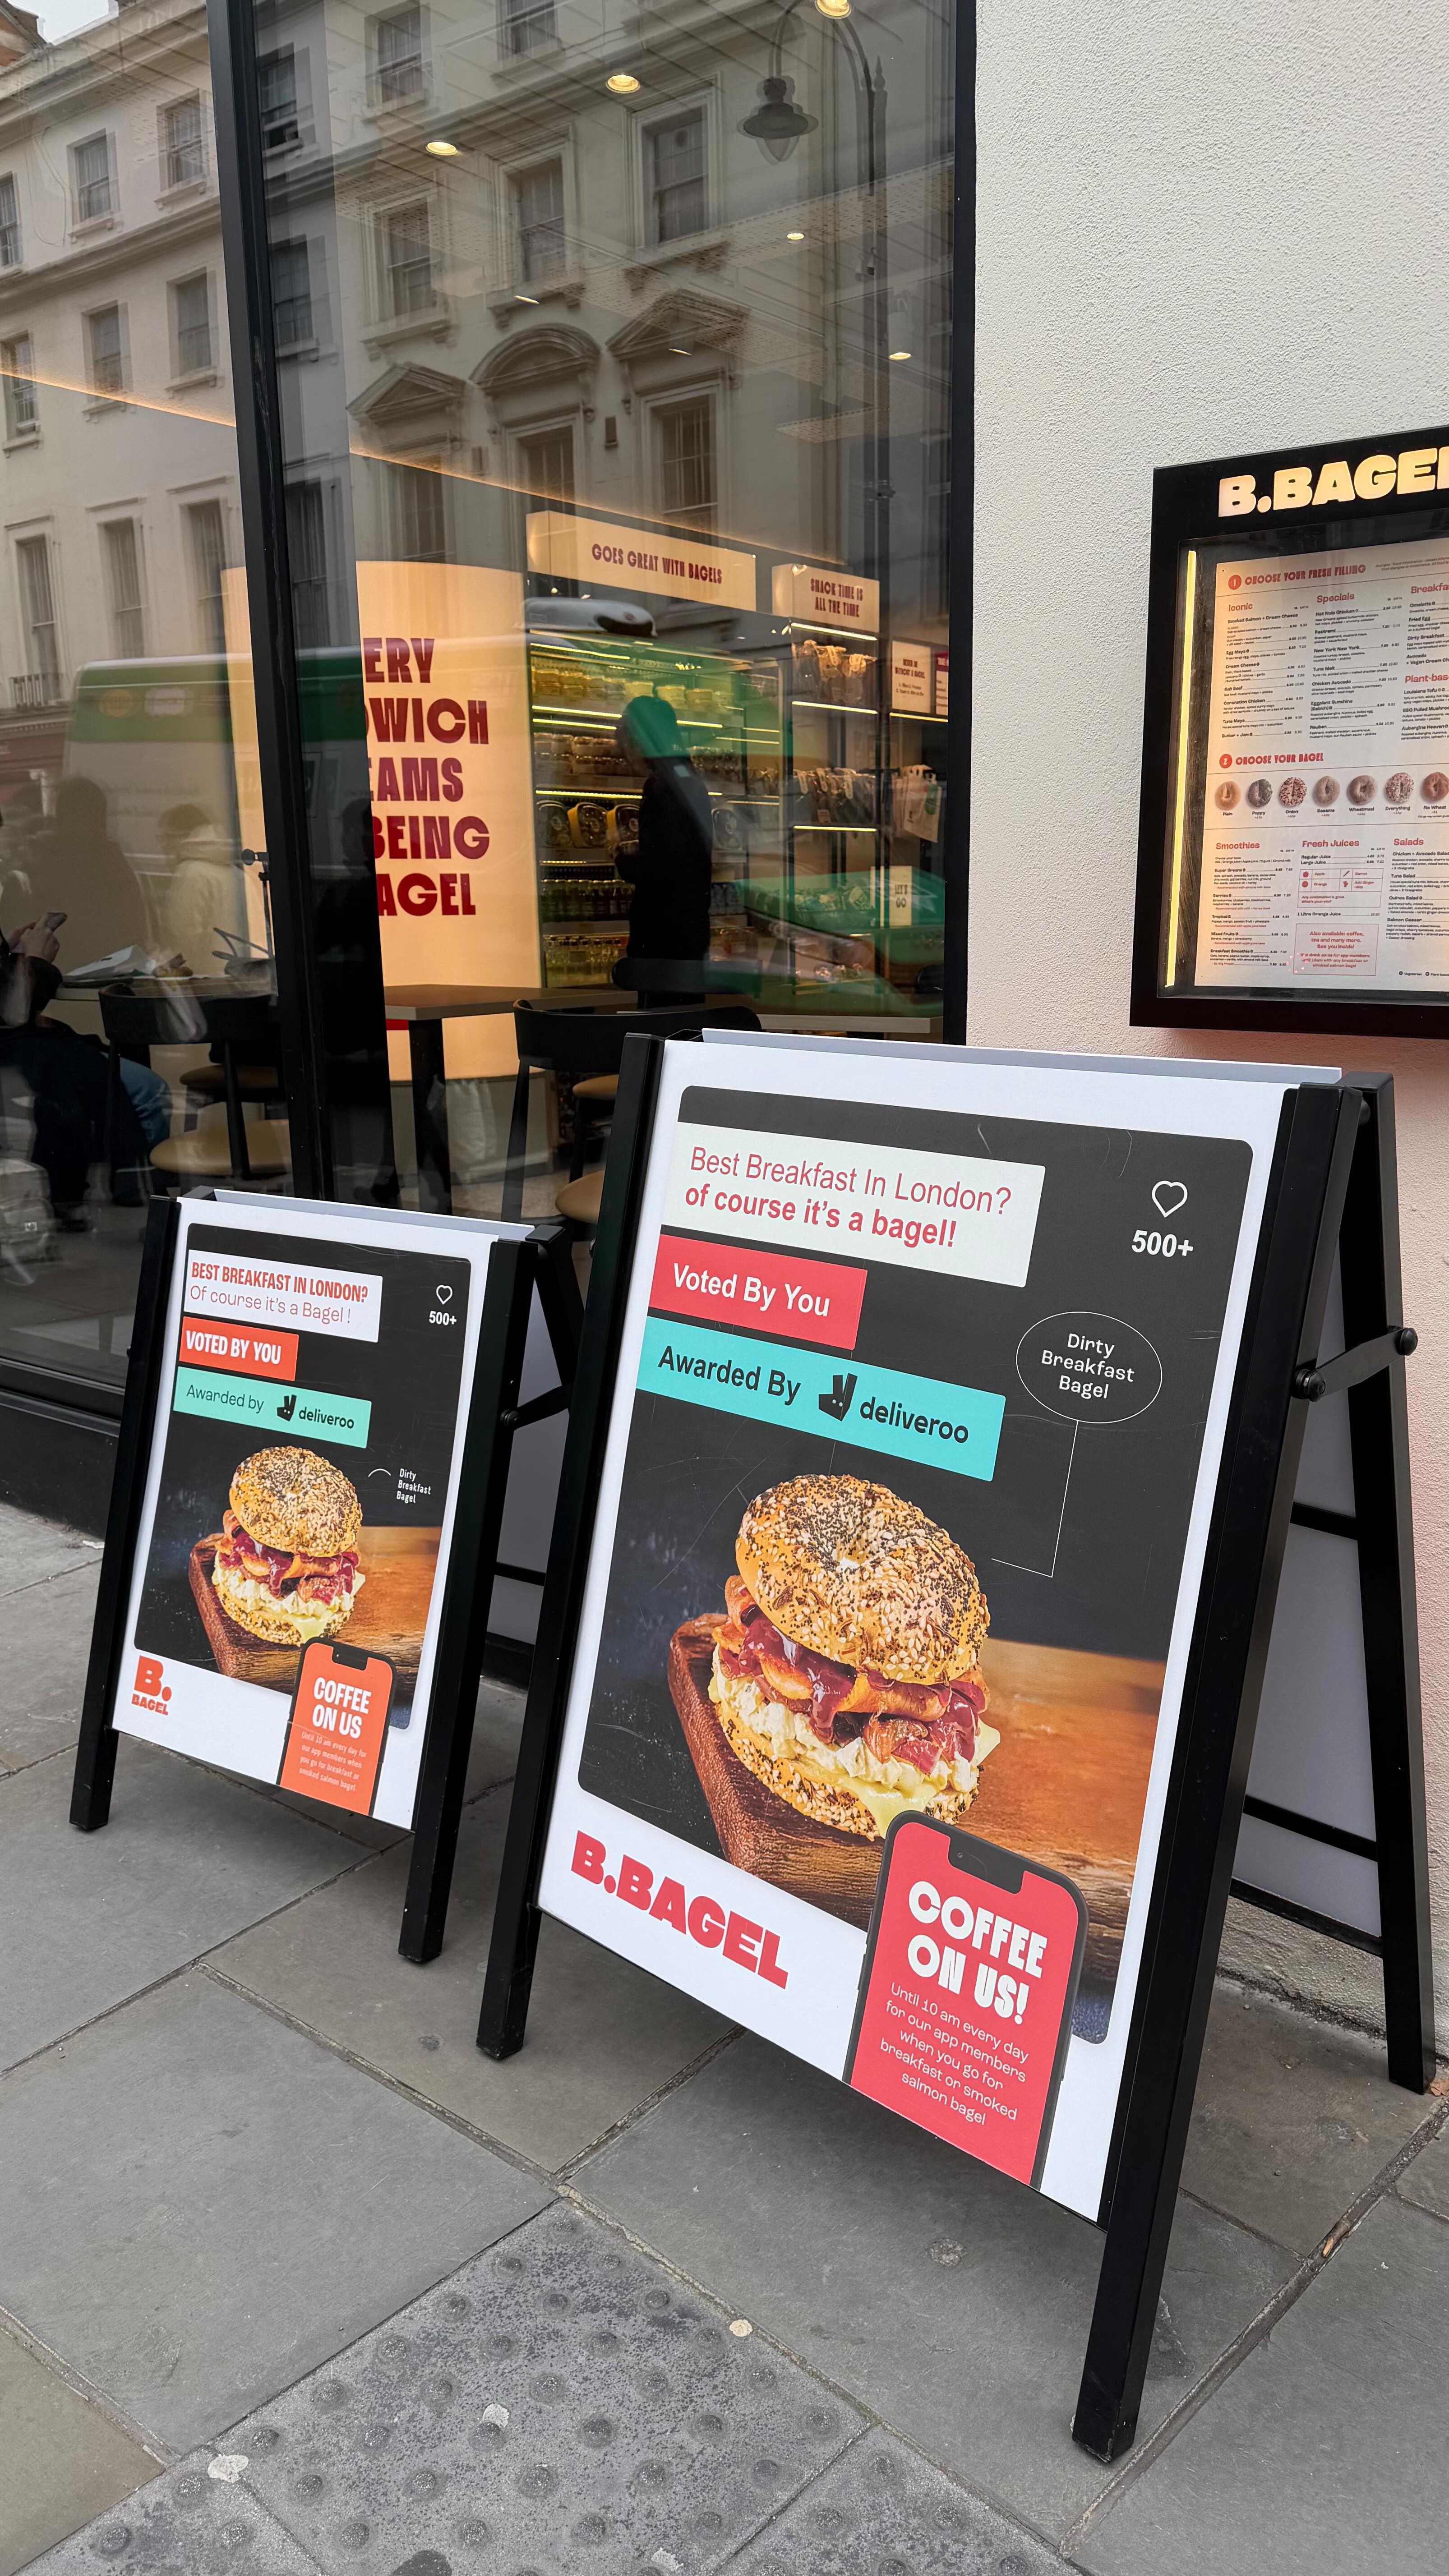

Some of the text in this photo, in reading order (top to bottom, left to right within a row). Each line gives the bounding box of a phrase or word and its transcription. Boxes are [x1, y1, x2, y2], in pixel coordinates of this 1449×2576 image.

[592, 543, 722, 584] GOES GREAT WITH BAGELS
[1245, 574, 1281, 585] CHOOSE
[1284, 571, 1306, 581] YOUR
[1309, 568, 1332, 579] FRESH
[1334, 564, 1366, 576] FILLING
[811, 579, 863, 601] SNACK TIME IS
[1317, 593, 1354, 604] Specials
[1411, 582, 1449, 594] Breakfa
[815, 597, 859, 617] ALL THE TIME
[1228, 603, 1253, 612] Iconic
[363, 638, 435, 683] ERY
[1405, 674, 1449, 683] Plant-bas
[365, 698, 489, 745] WICH
[1236, 755, 1271, 765] CHOOSE
[1274, 754, 1296, 763] YOUR
[1299, 753, 1324, 762] BAGEL
[376, 873, 476, 916] AGEL
[690, 1146, 1011, 1215] Best Breakfast In London?
[685, 1184, 957, 1248] of course it's a bagel!
[1131, 1229, 1193, 1257] 500+
[191, 1262, 368, 1303] BEST BREAKFAST IN LONDON?
[673, 1262, 831, 1317] Voted By You
[190, 1285, 208, 1300] Of
[210, 1290, 262, 1310] course
[265, 1297, 286, 1313] it's
[290, 1303, 298, 1316] a
[302, 1302, 343, 1325] Bagel
[429, 1311, 457, 1326] 500+
[186, 1330, 282, 1365] VOTED BY YOU
[1067, 1333, 1115, 1358] Dirty
[1042, 1350, 1135, 1382] Breakfast
[658, 1345, 969, 1444] Awarded By deliveroo
[1059, 1375, 1109, 1399] Bagel
[186, 1384, 354, 1429] Awarded by deliveroo
[398, 1480, 431, 1495] Breakfast
[400, 1468, 416, 1481] Dirty
[397, 1490, 416, 1504] Bagel
[134, 1655, 172, 1702] B.
[314, 1677, 372, 1714] COFFEE
[131, 1693, 169, 1716] BAGEL
[312, 1704, 362, 1739] ON US
[301, 1731, 367, 1757] Until 10 am every day for
[302, 1744, 362, 1768] our app members when
[299, 1767, 356, 1791] smoked salmon bagel
[318, 1760, 327, 1770] for
[327, 1763, 352, 1779] breakfast
[571, 1830, 788, 1990] B.BAGEL
[909, 1881, 1048, 1978] COFFEE
[907, 1934, 1029, 2025] ON US!
[891, 1982, 1029, 2063] Until 10 am every day
[886, 1999, 1026, 2083] for our app members
[900, 2030, 1003, 2091] when you go for
[880, 2038, 1018, 2121] breakfast or smoked
[902, 2072, 987, 2125] salmon bagel
